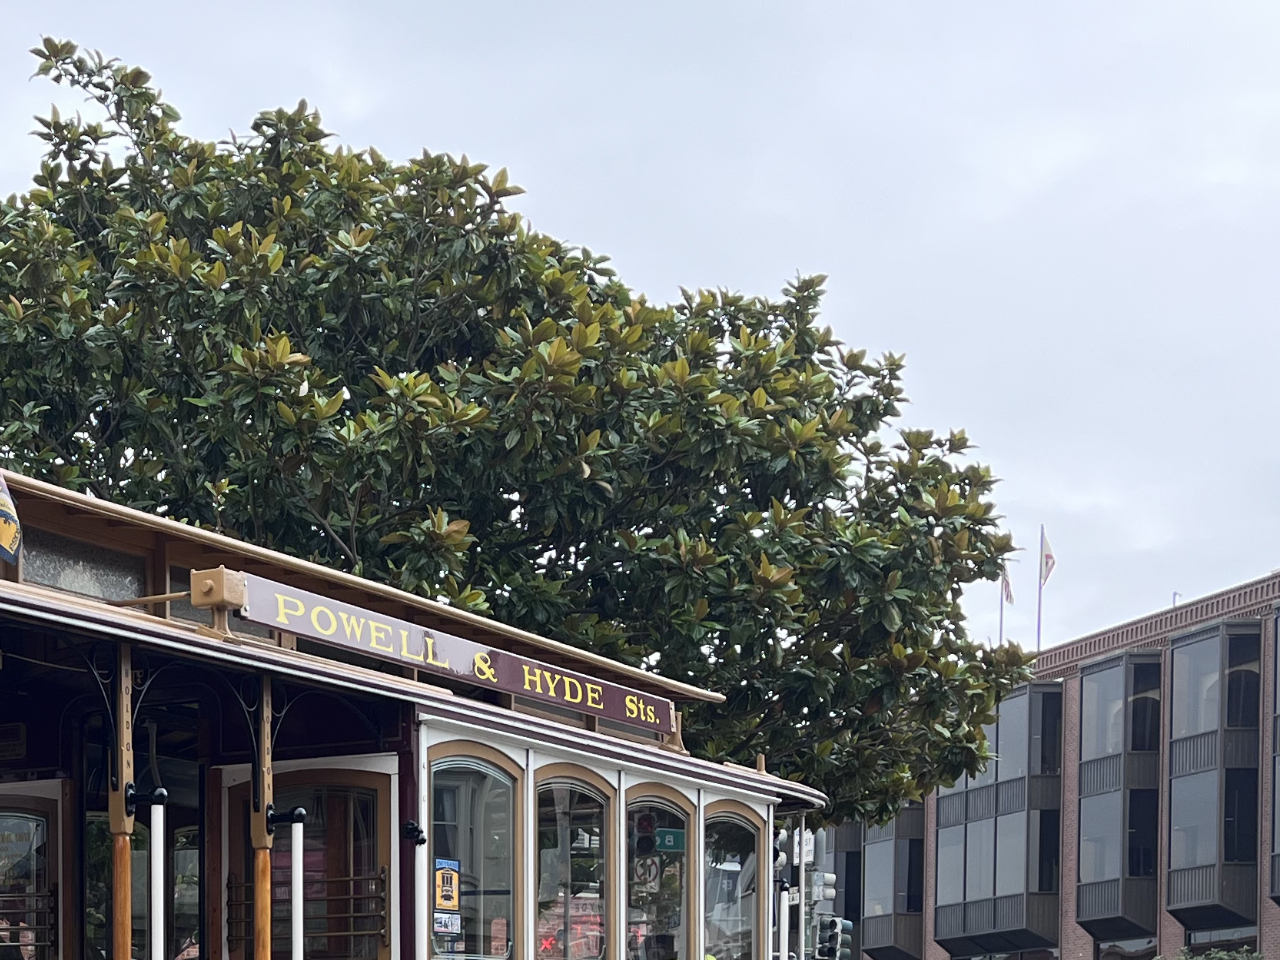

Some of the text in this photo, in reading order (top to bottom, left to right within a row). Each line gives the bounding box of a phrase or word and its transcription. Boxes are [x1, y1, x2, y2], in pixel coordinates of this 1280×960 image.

[274, 592, 661, 725] POWELL & HYDE Sts.
